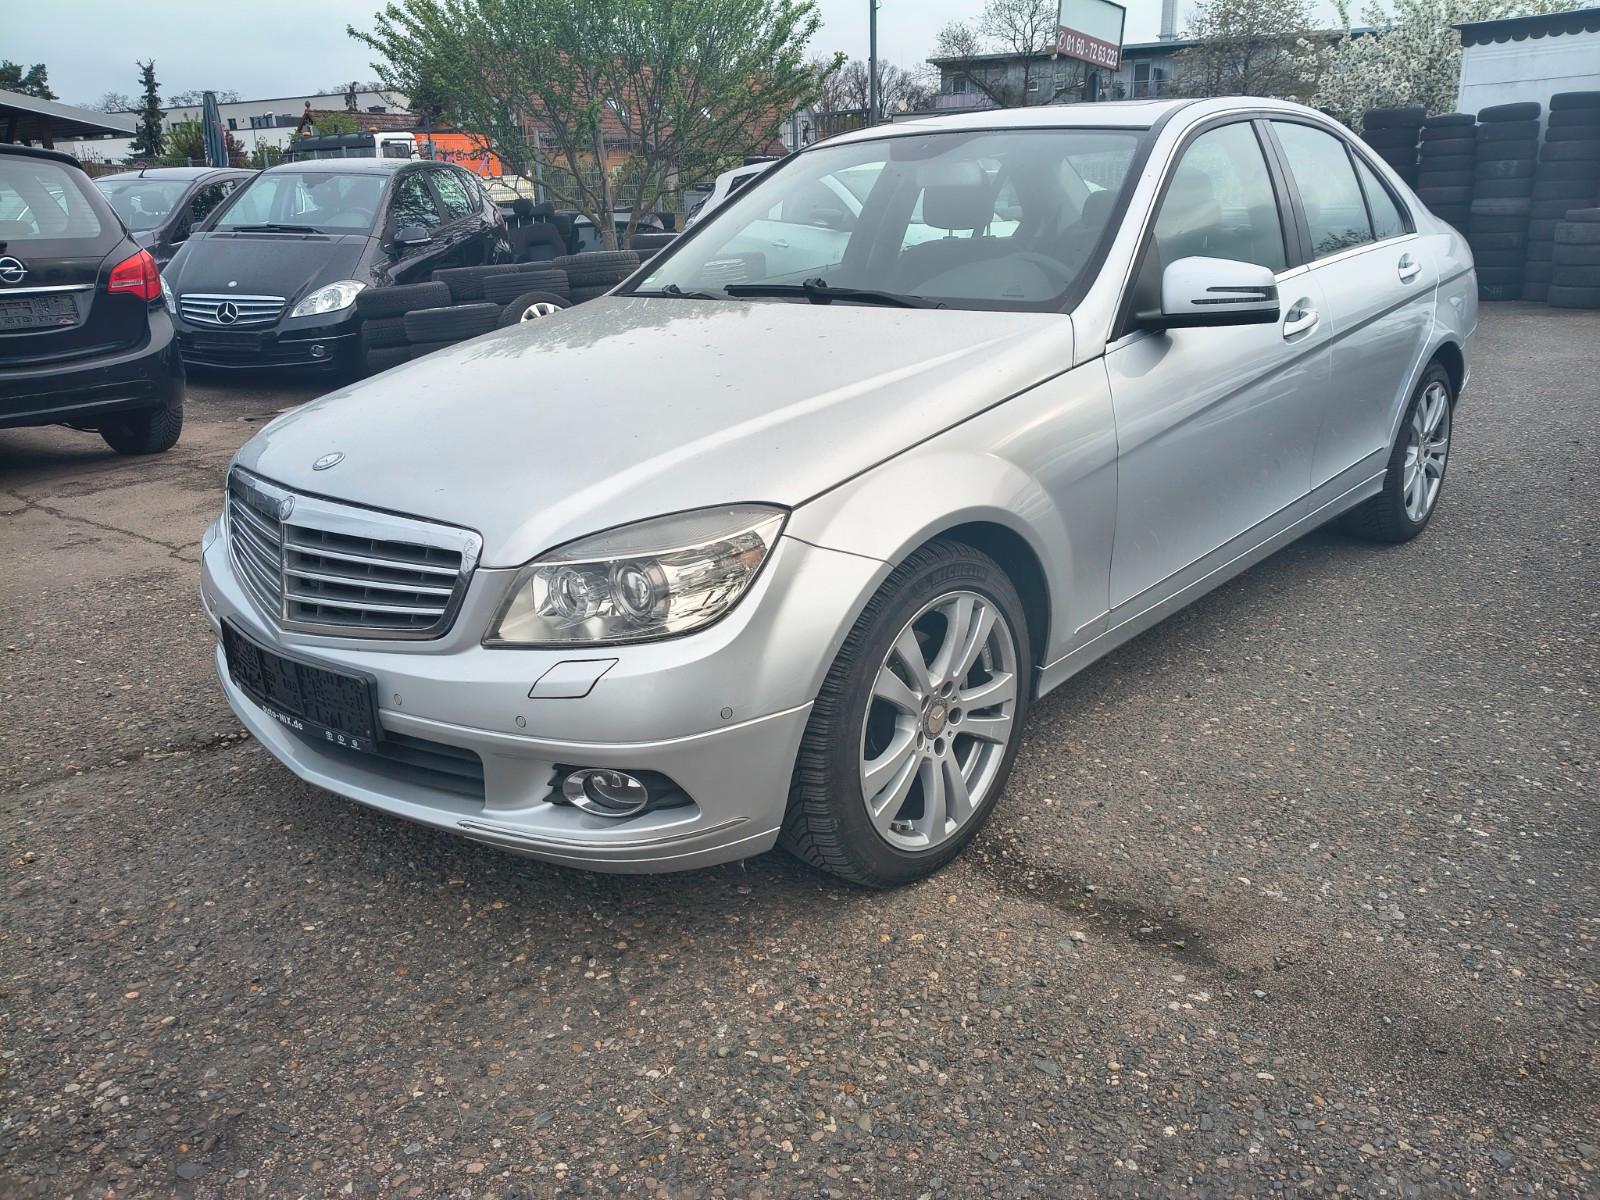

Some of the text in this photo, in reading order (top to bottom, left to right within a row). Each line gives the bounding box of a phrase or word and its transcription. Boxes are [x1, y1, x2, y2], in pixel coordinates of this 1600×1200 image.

[1066, 34, 1074, 53] 01
[1089, 42, 1097, 59] 72
[1106, 49, 1118, 66] 223
